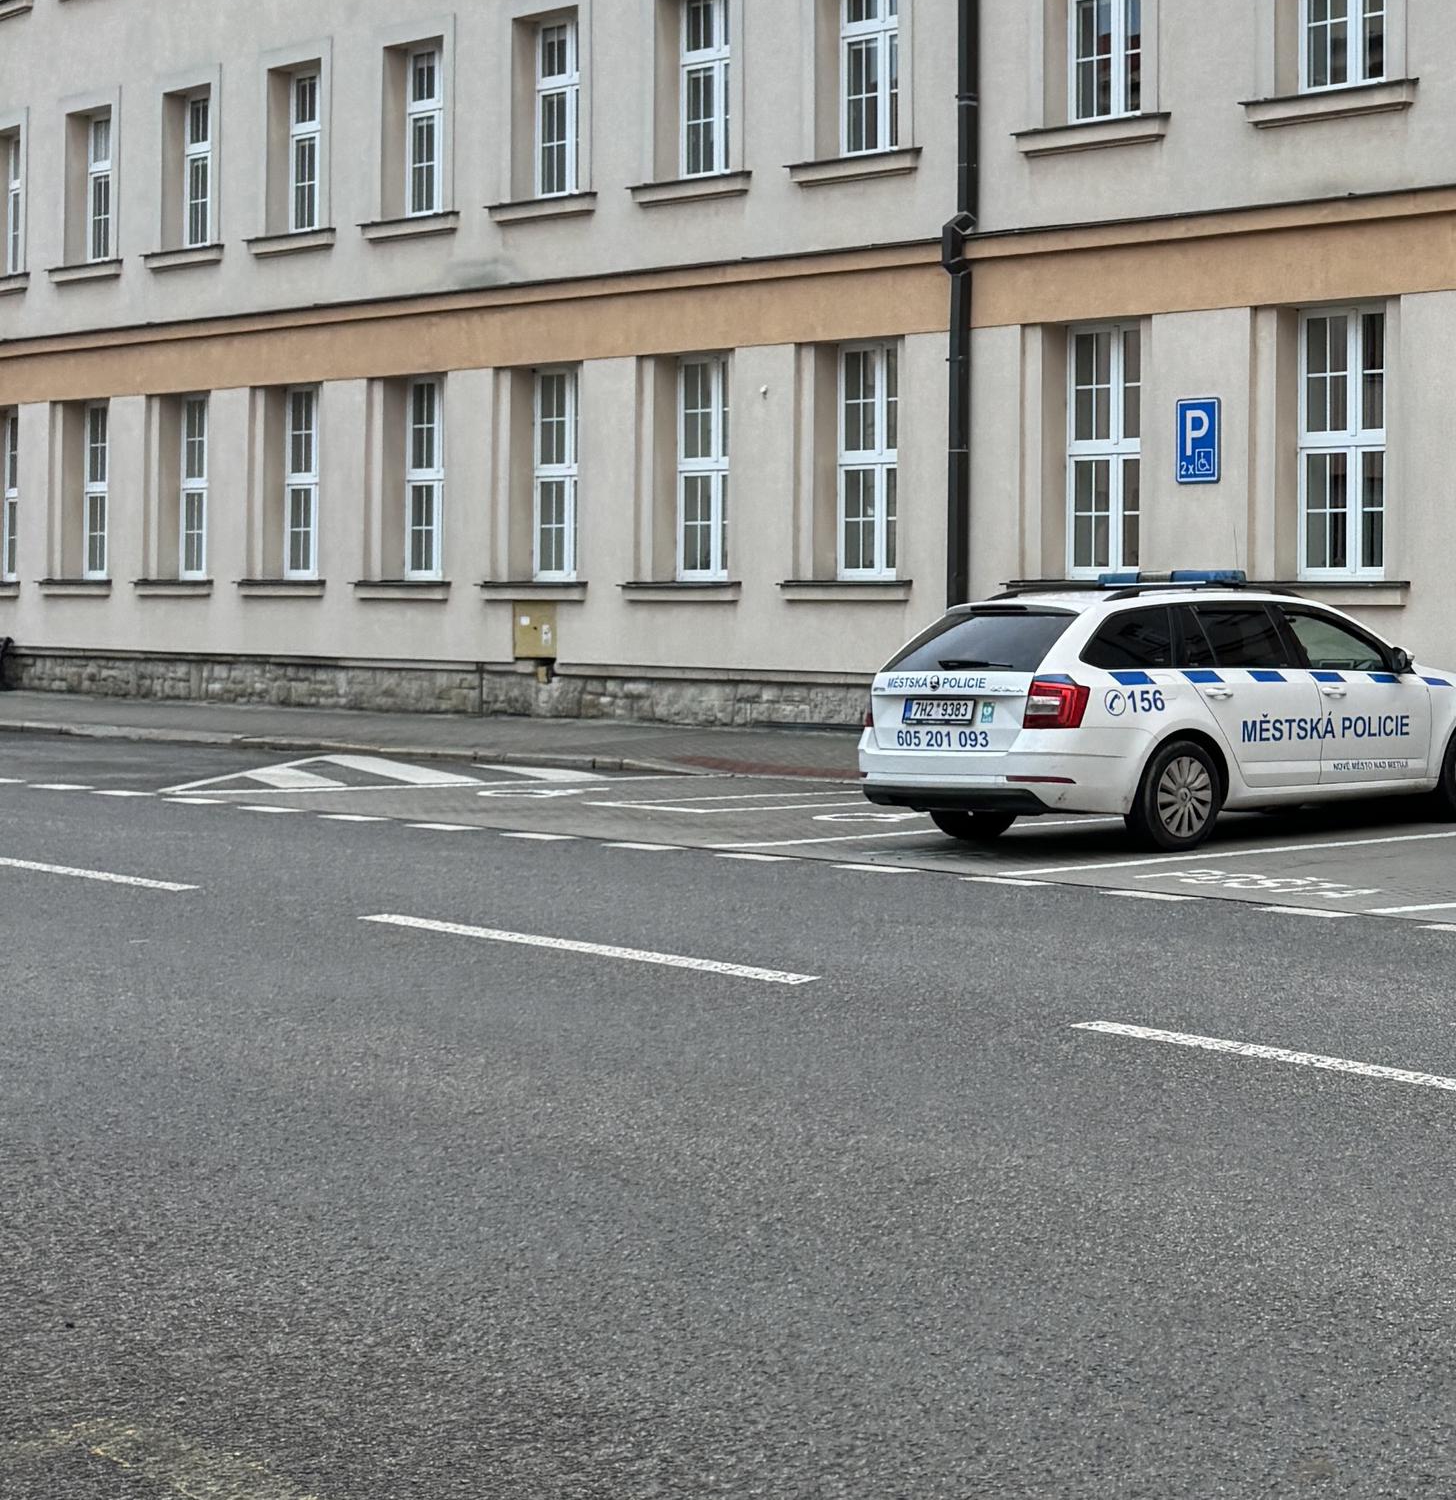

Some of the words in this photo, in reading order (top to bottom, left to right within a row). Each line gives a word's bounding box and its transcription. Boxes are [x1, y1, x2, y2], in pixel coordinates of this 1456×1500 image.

[1185, 409, 1210, 456] P
[887, 673, 929, 689] MĚSTSKÁ
[941, 676, 987, 690] POLICIE
[913, 701, 936, 717] 7H2
[940, 702, 969, 718] 9383
[1126, 689, 1166, 713] 156
[1241, 710, 1336, 743] MĚSTSKÁ
[1341, 714, 1411, 739] POLICIE
[896, 729, 922, 748] 605
[926, 729, 952, 749] 201
[958, 730, 990, 749] 093
